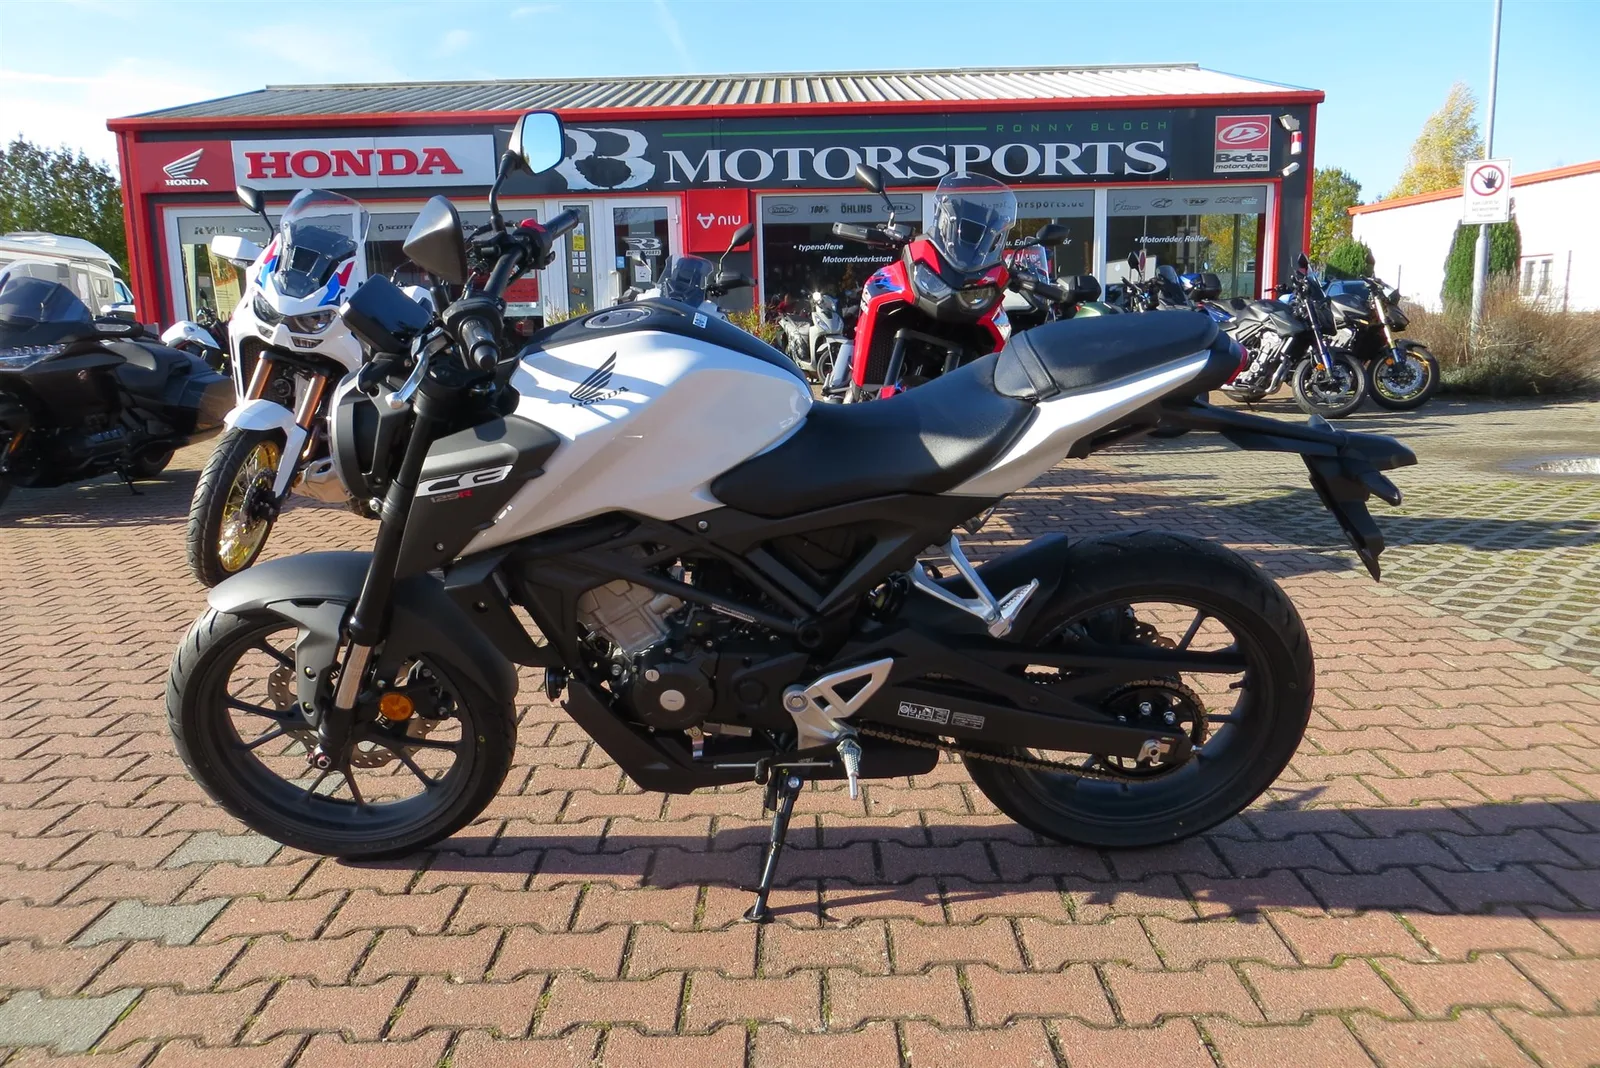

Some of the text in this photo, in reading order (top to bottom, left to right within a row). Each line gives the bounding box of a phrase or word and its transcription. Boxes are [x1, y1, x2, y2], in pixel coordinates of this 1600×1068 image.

[996, 121, 1167, 133] RONNY BLOCH
[244, 148, 464, 180] HONDA
[662, 140, 1168, 184] MOTORSPORTS
[1215, 153, 1269, 163] Beta
[840, 202, 873, 214] ÖHLINS
[798, 243, 844, 251] typenoffene
[822, 255, 893, 263] Motorradwerkstatt
